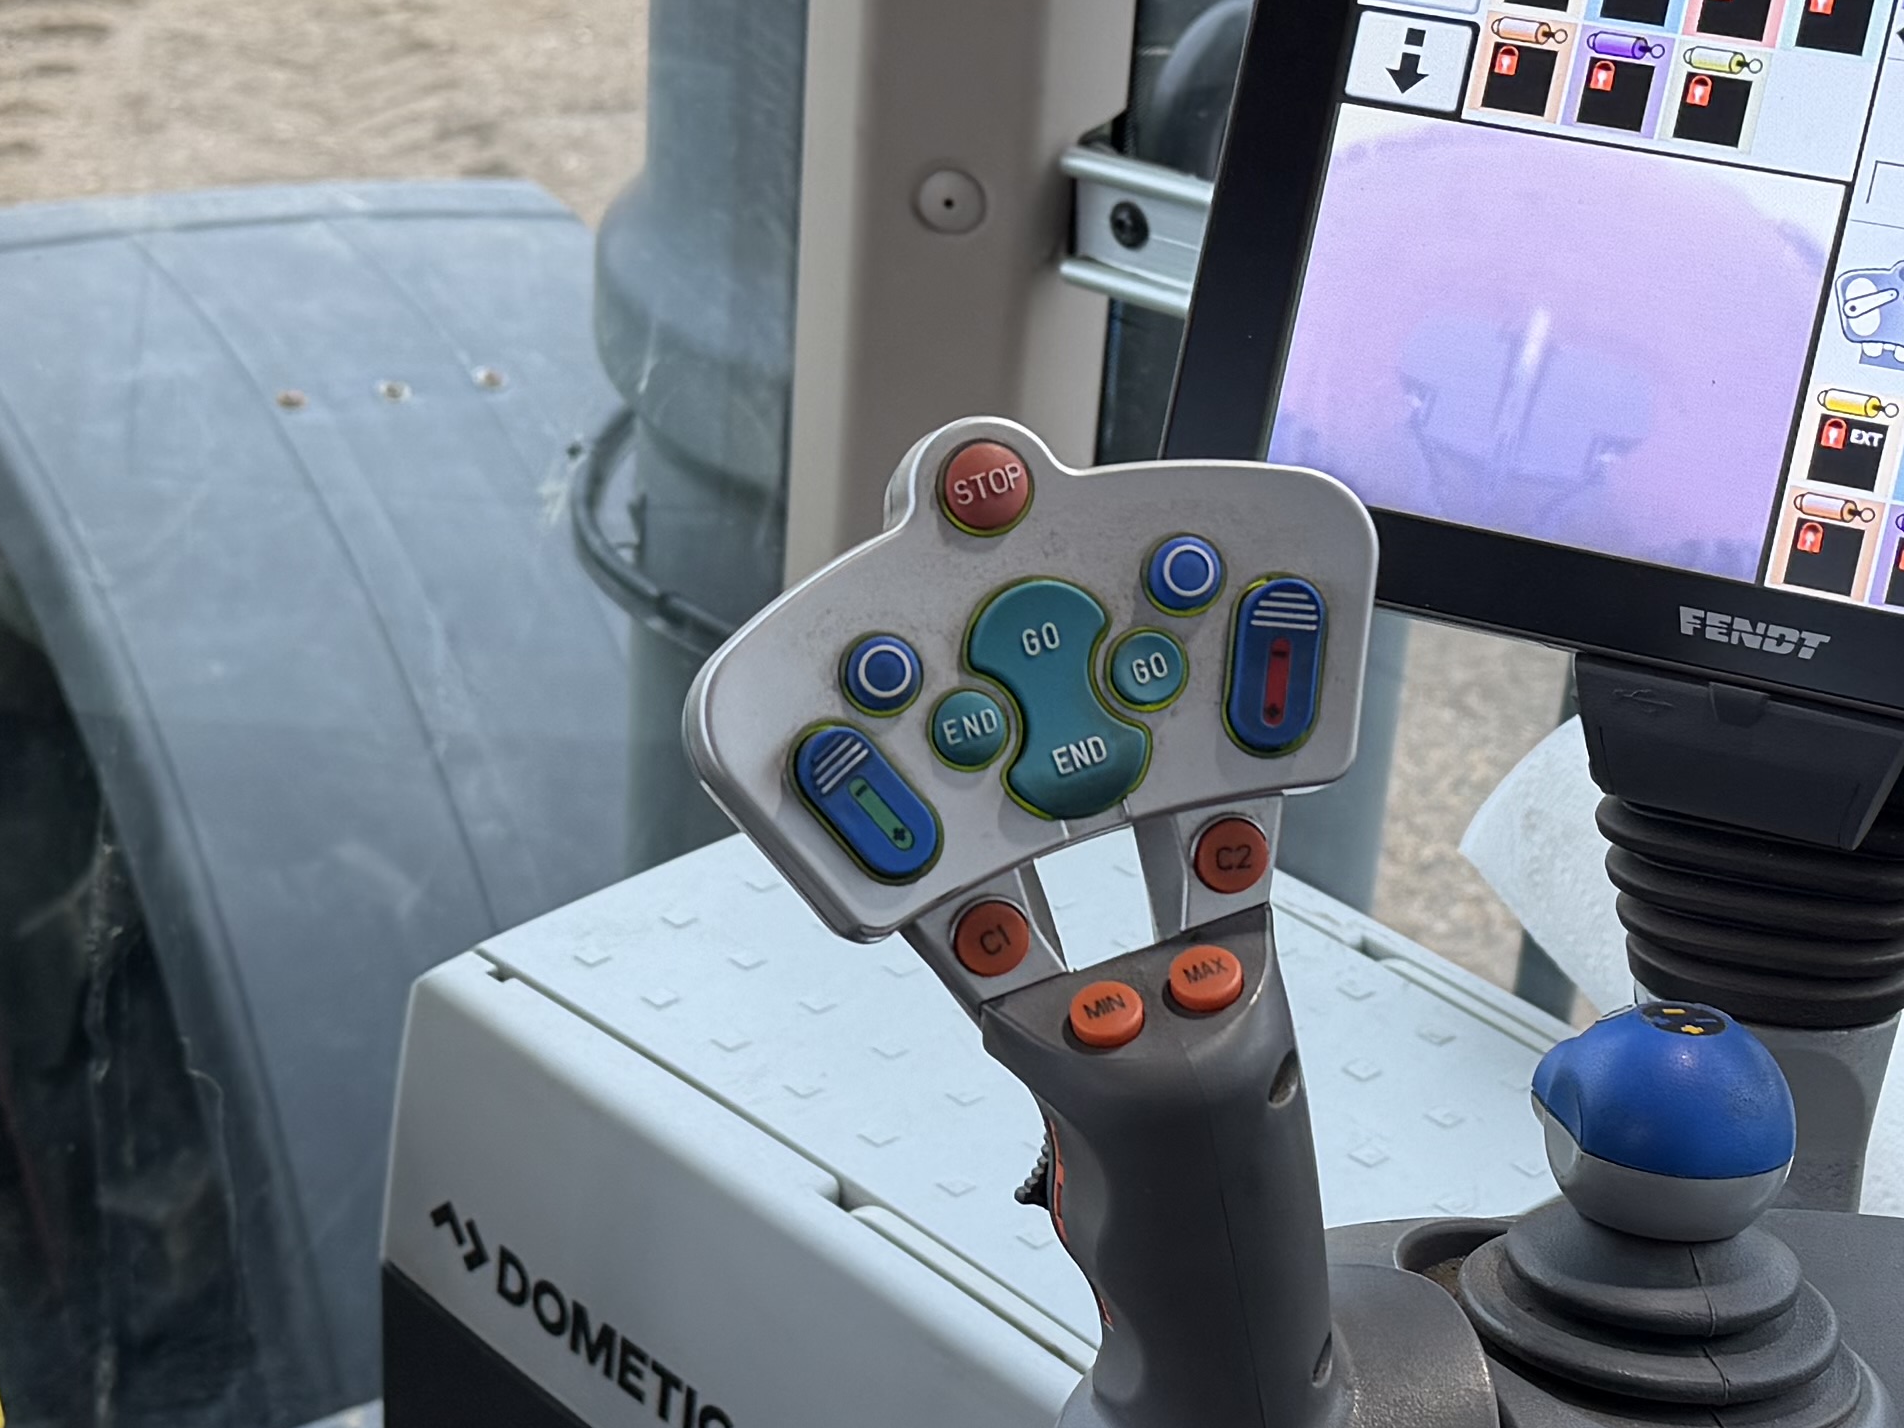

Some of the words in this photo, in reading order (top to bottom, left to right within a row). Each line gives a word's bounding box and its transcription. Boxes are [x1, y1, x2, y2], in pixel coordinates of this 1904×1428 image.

[1849, 429, 1884, 448] EXT
[953, 462, 1023, 506] STOP
[1022, 622, 1061, 657] GO
[1679, 606, 1831, 660] FENDT
[1132, 652, 1168, 684] GO
[942, 708, 998, 746] END
[1052, 735, 1107, 775] END
[1216, 845, 1252, 872] C2
[980, 926, 1011, 953] C1
[1183, 956, 1228, 985] MAX
[1084, 992, 1126, 1020] MIN
